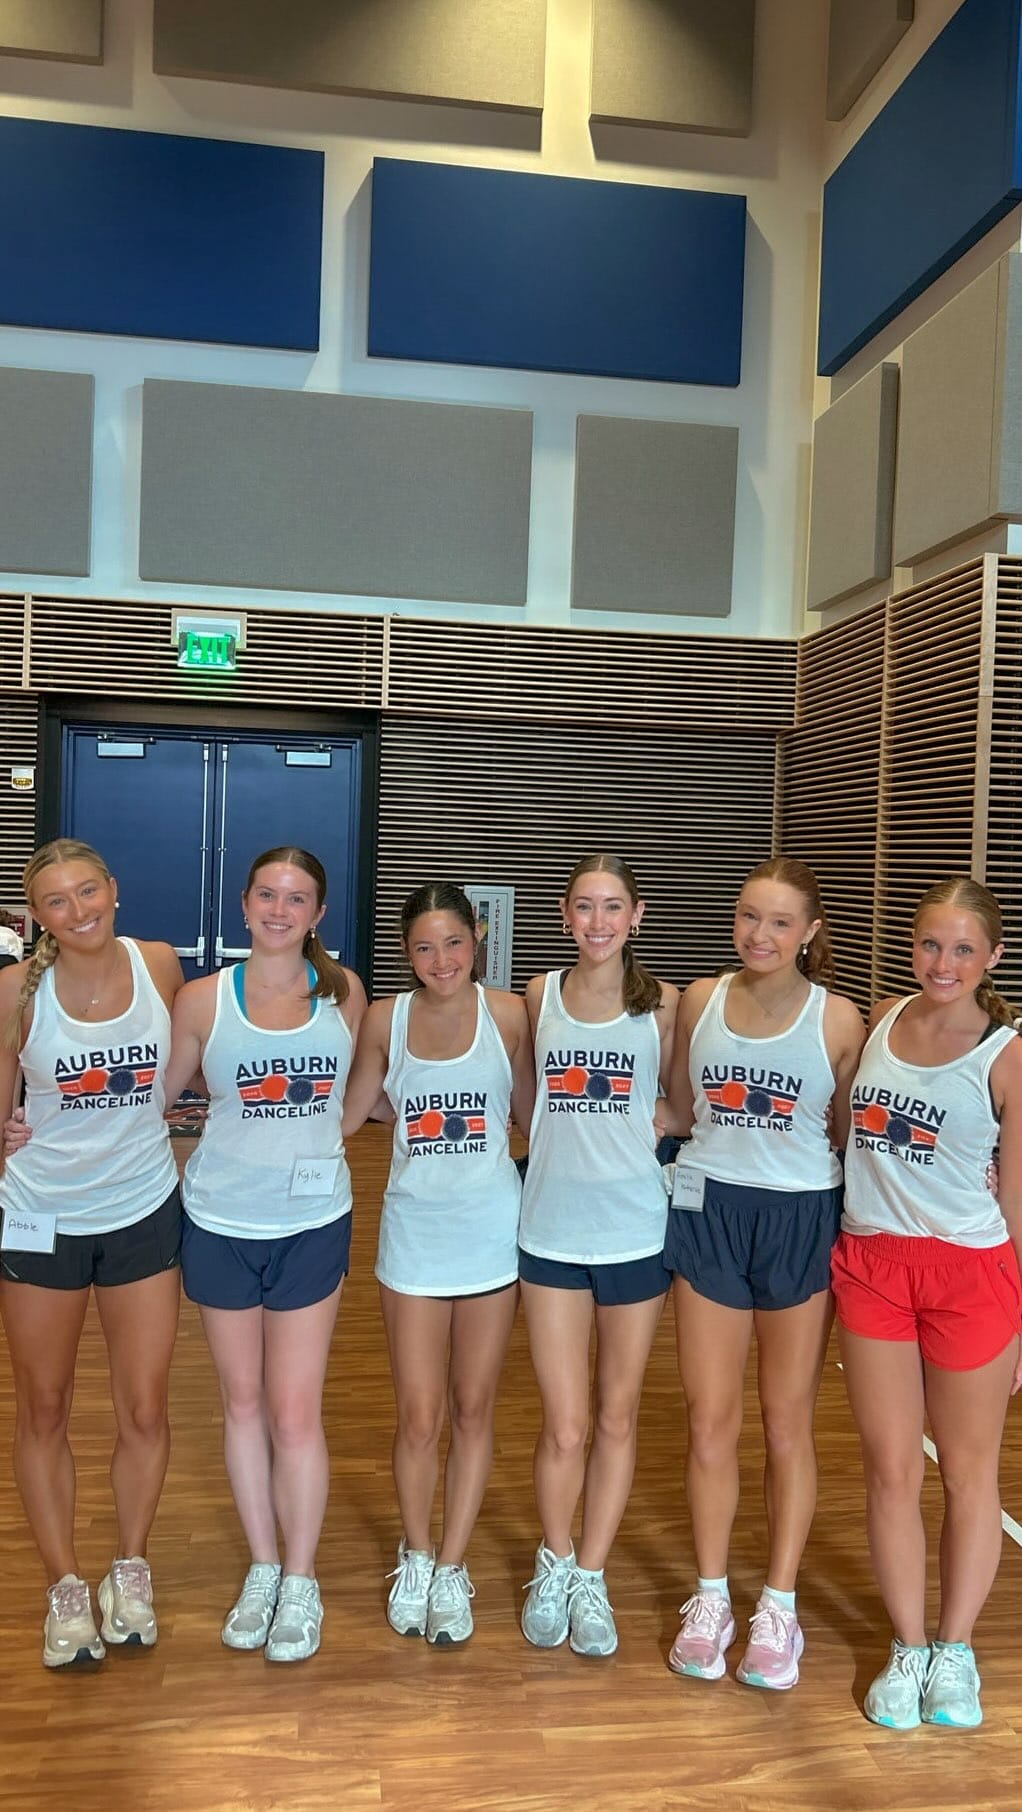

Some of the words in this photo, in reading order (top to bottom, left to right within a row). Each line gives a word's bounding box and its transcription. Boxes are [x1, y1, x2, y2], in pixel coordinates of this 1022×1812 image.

[187, 632, 230, 664] EXIT
[492, 921, 500, 981] EXTINGUISHER
[55, 1043, 159, 1075] AUBURN
[236, 1056, 338, 1080] AUBURN
[545, 1050, 635, 1071] AUBURN
[701, 1065, 803, 1094] AUBURN
[60, 1092, 152, 1111] DANCELINE
[242, 1102, 328, 1119] DANCELINE
[405, 1092, 487, 1115] AUBURN
[548, 1101, 630, 1115] DANCELINE
[852, 1085, 947, 1127] AUBURN
[710, 1112, 793, 1132] DANCELINE
[855, 1137, 934, 1165] DNCELINE
